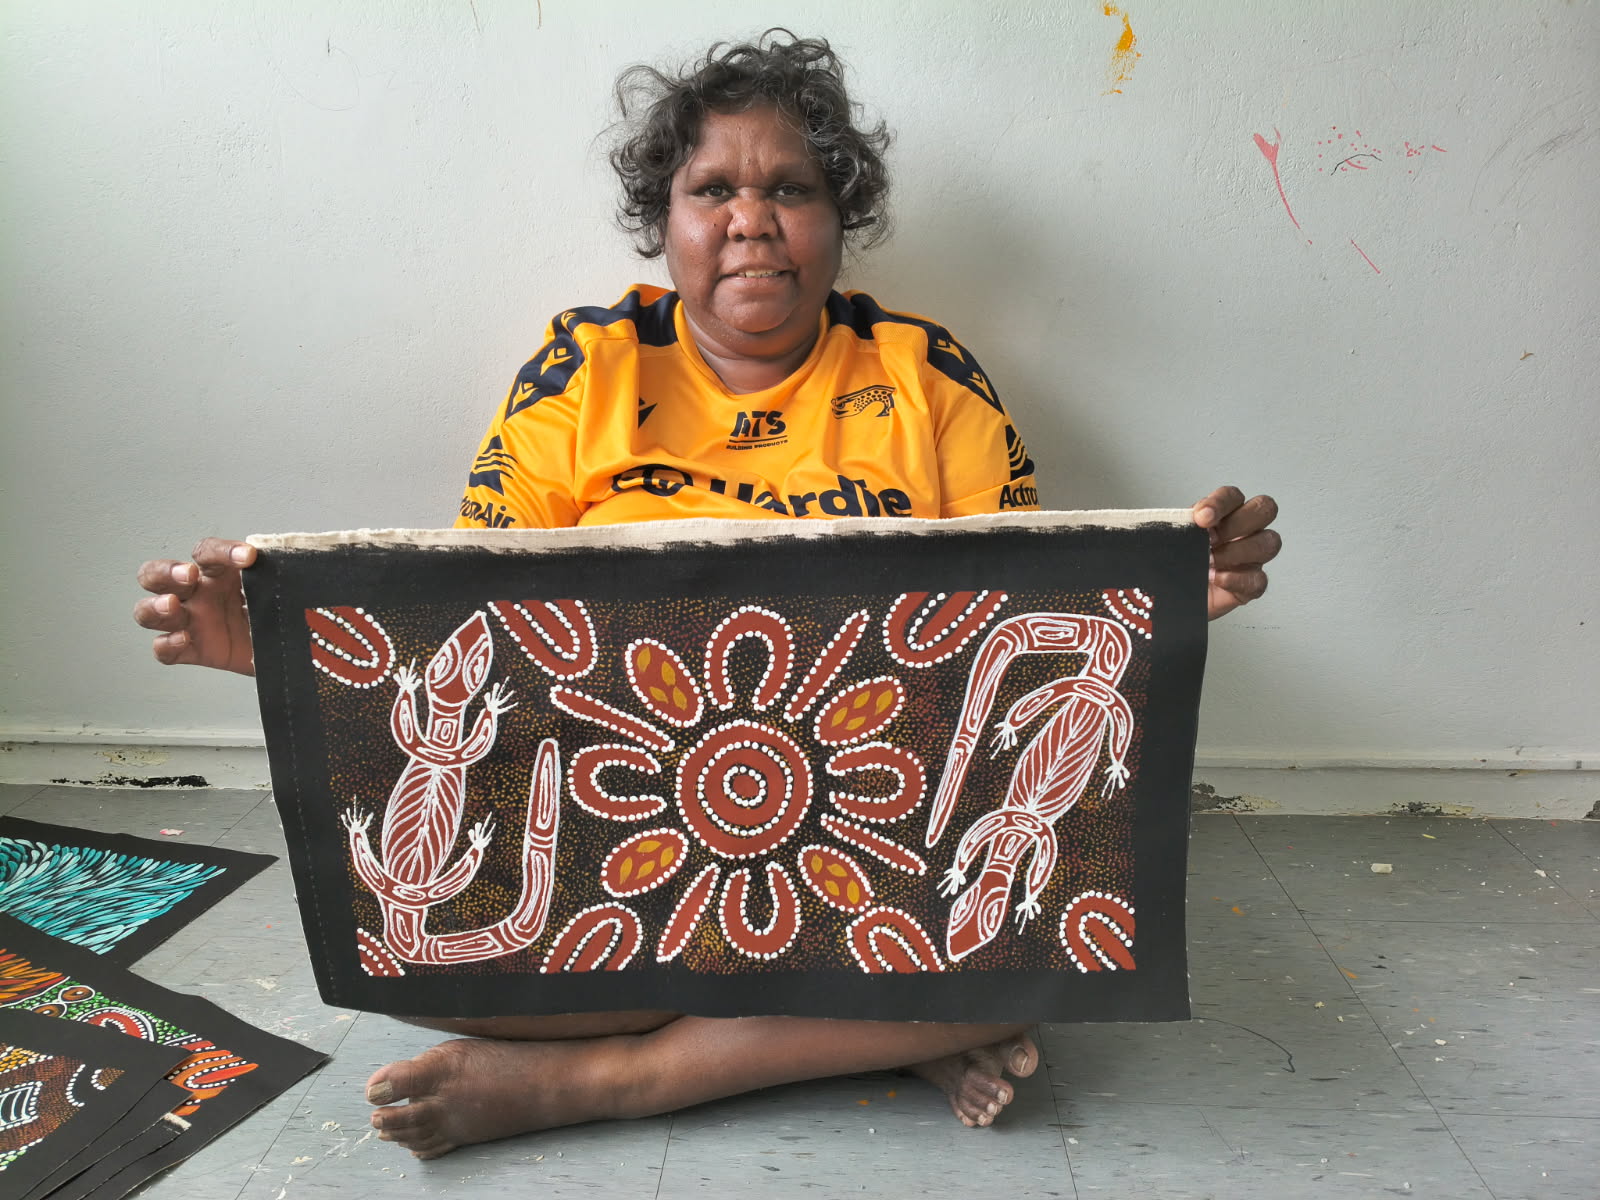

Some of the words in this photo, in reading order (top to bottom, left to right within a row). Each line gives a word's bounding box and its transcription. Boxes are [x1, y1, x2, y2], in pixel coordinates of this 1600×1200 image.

[730, 410, 786, 438] ATS
[754, 439, 788, 449] PRODUCTS
[999, 482, 1039, 510] Actro
